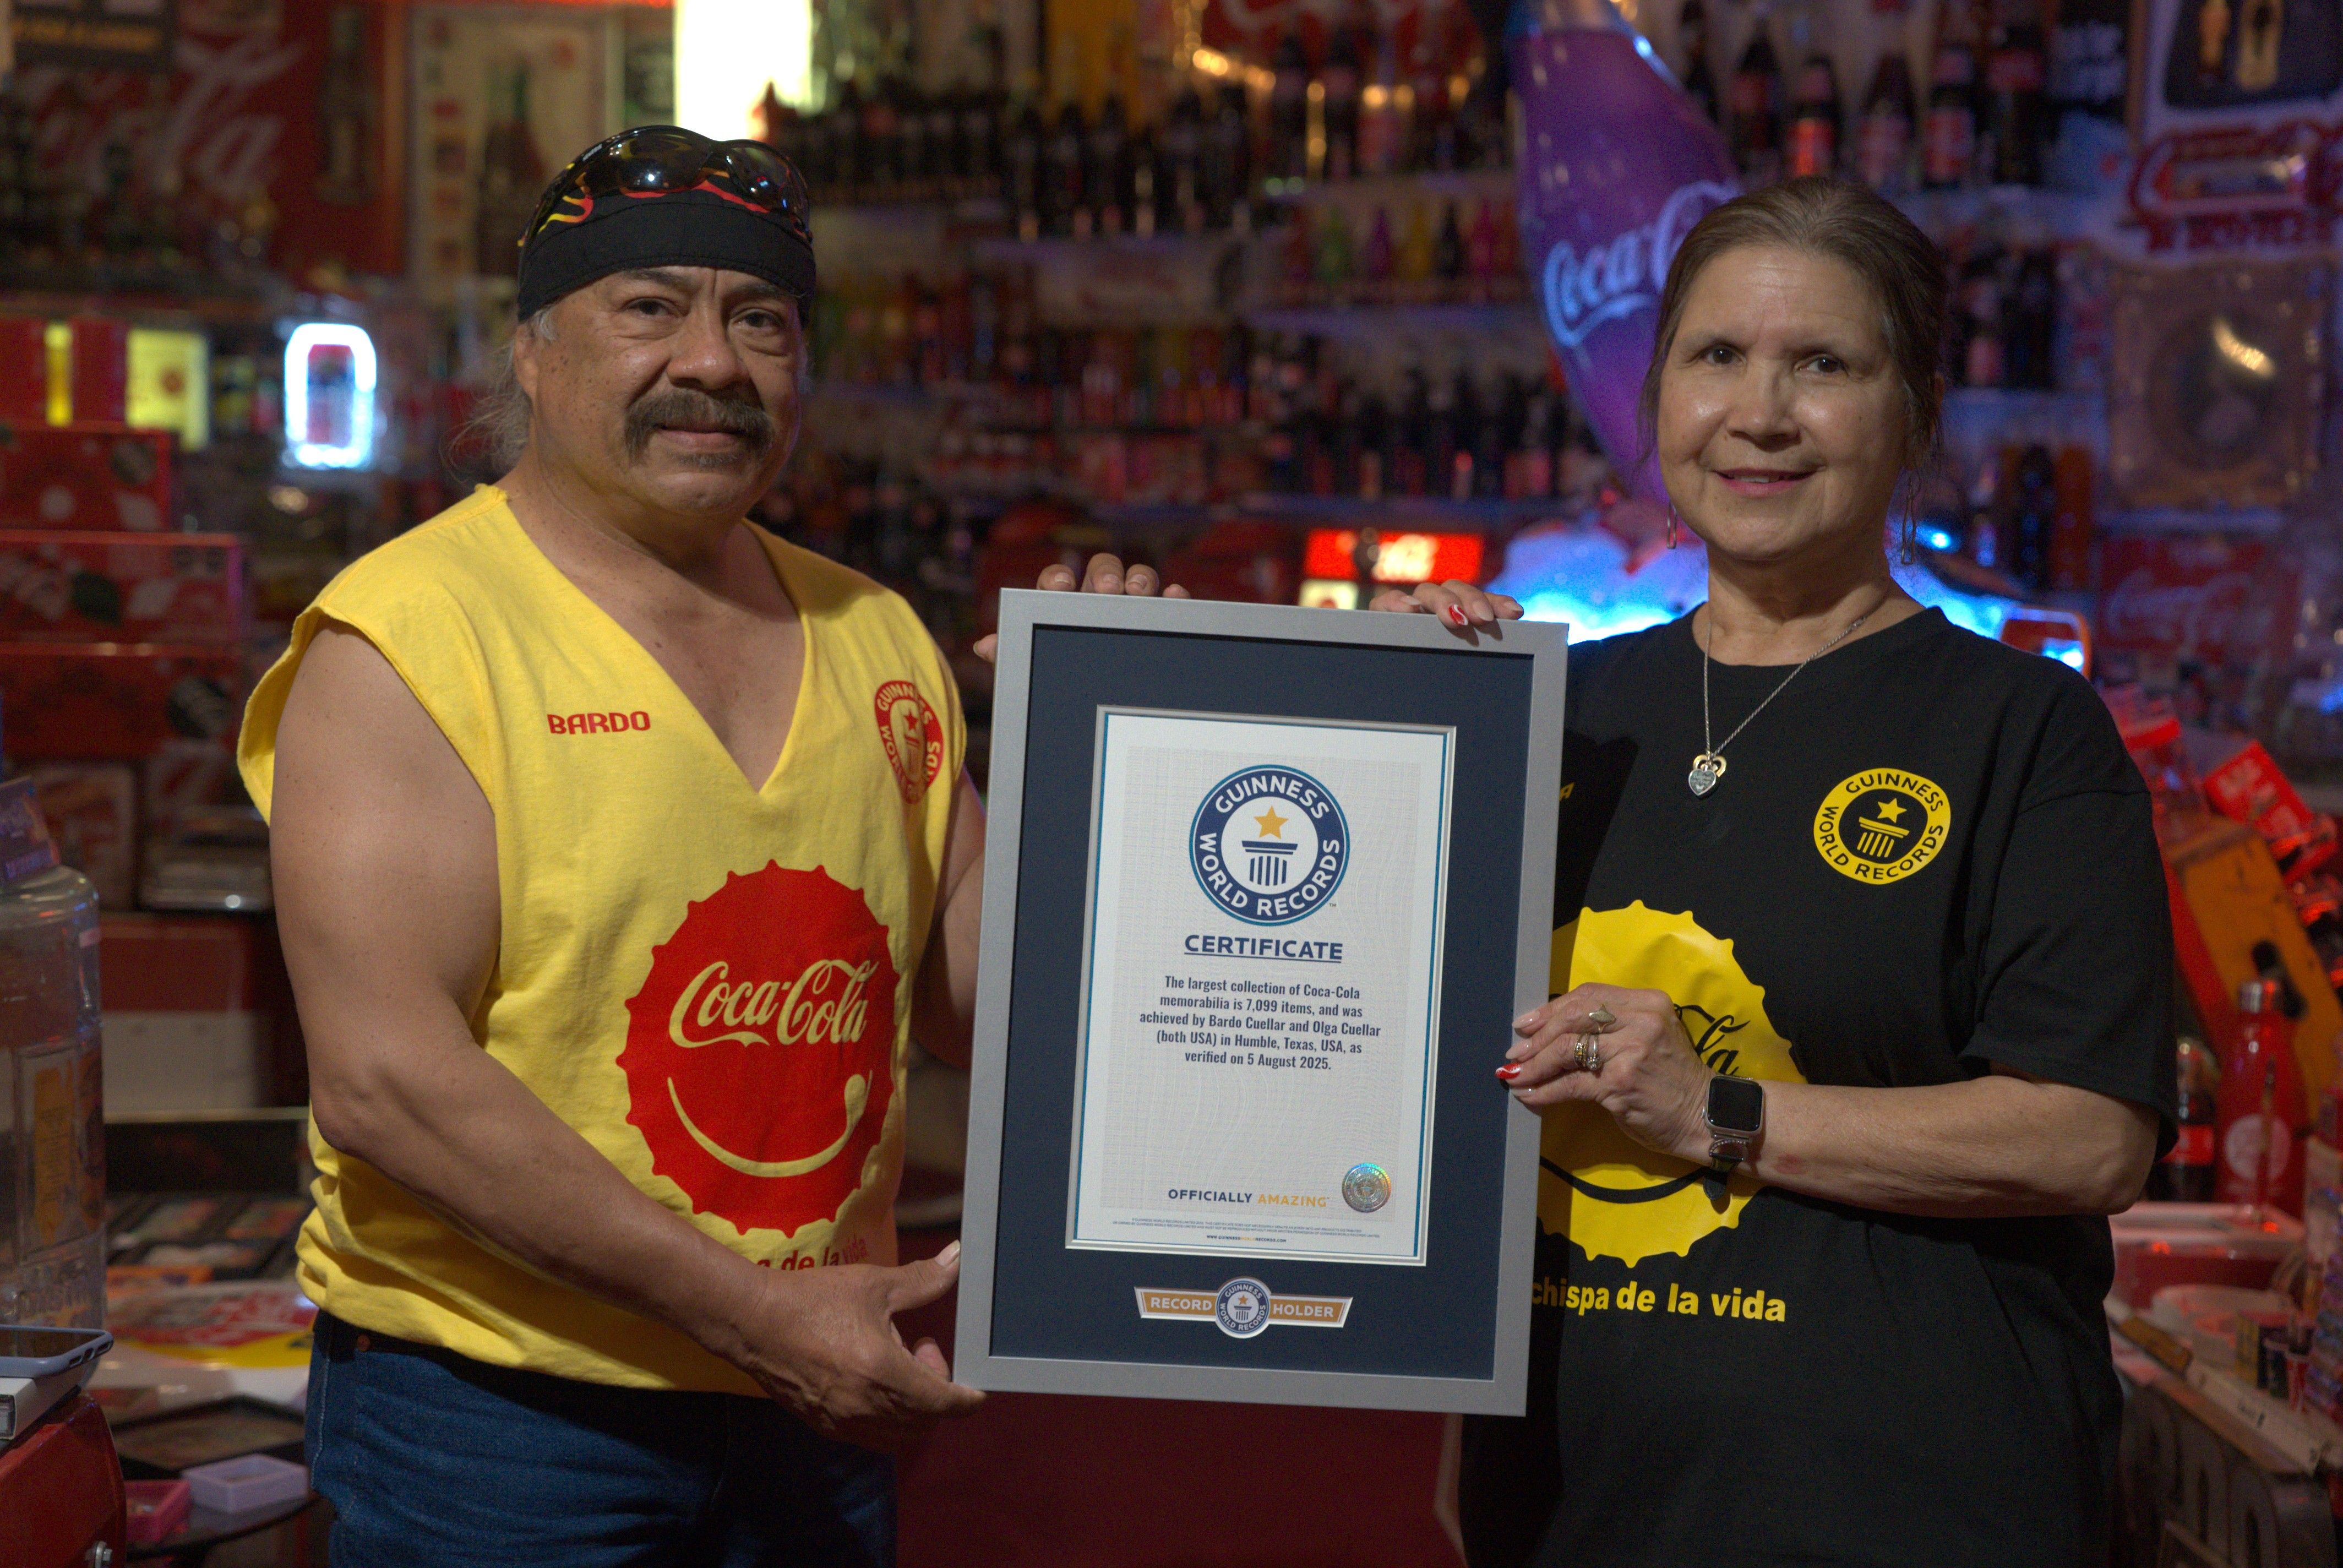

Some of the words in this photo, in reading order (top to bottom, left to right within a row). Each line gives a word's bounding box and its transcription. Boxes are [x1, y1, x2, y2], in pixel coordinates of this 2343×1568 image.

[547, 710, 651, 735] BARDO
[1215, 775, 1329, 819] GUINNESS
[1845, 773, 1943, 812] GUINNESS
[1819, 807, 1849, 866] WORLD
[1855, 825, 1943, 880] RECORDS
[1199, 832, 1248, 908] WORLD
[1257, 839, 1340, 917] RECORDS
[1185, 934, 1343, 960] CERTIFICATE
[1165, 976, 1184, 988] The
[1188, 977, 1227, 993] largest
[1230, 981, 1285, 995] collection
[1289, 984, 1300, 995] of
[1304, 984, 1360, 999] Coca-Cola
[668, 959, 879, 1049] Coca-Cola
[1160, 996, 1229, 1010] memorabilia
[1233, 998, 1243, 1010] is
[1246, 999, 1278, 1012] 7,099
[1281, 1001, 1315, 1016] items,
[1318, 1004, 1339, 1016] and
[1343, 1008, 1363, 1017] was
[1140, 1011, 1189, 1025] achieved
[1192, 1014, 1206, 1028] by
[1209, 1015, 1241, 1028] Bardo
[1246, 1017, 1285, 1031] Cuellar
[1289, 1020, 1309, 1032] and
[1312, 1021, 1338, 1036] Olga
[1341, 1022, 1381, 1037] Cuellar
[1157, 1030, 1186, 1044] (both
[1190, 1031, 1217, 1047] USA)
[1220, 1034, 1230, 1046] in
[1235, 1035, 1280, 1050] Humble,
[1284, 1037, 1317, 1052] Texas,
[1321, 1039, 1346, 1054] USA,
[1349, 1044, 1362, 1053] as
[1185, 1050, 1227, 1064] verified
[1230, 1055, 1244, 1065] on
[1247, 1053, 1254, 1065] 5
[1258, 1054, 1296, 1069] August
[1300, 1057, 1332, 1070] 2025.
[1168, 1188, 1253, 1204] OFFICIALLY
[1257, 1193, 1327, 1208] AMAZING
[782, 1250, 815, 1271] de
[824, 1246, 840, 1266] la
[1225, 1283, 1263, 1299] GUINNESS
[1532, 1277, 1610, 1316] chispa
[1616, 1281, 1656, 1313] de
[1668, 1282, 1699, 1315] la
[1711, 1287, 1786, 1322] vida
[1150, 1296, 1212, 1311] RECORD
[1273, 1303, 1334, 1317] HOLDER
[1220, 1302, 1236, 1329] WORLD
[1238, 1304, 1266, 1331] RECORDS
